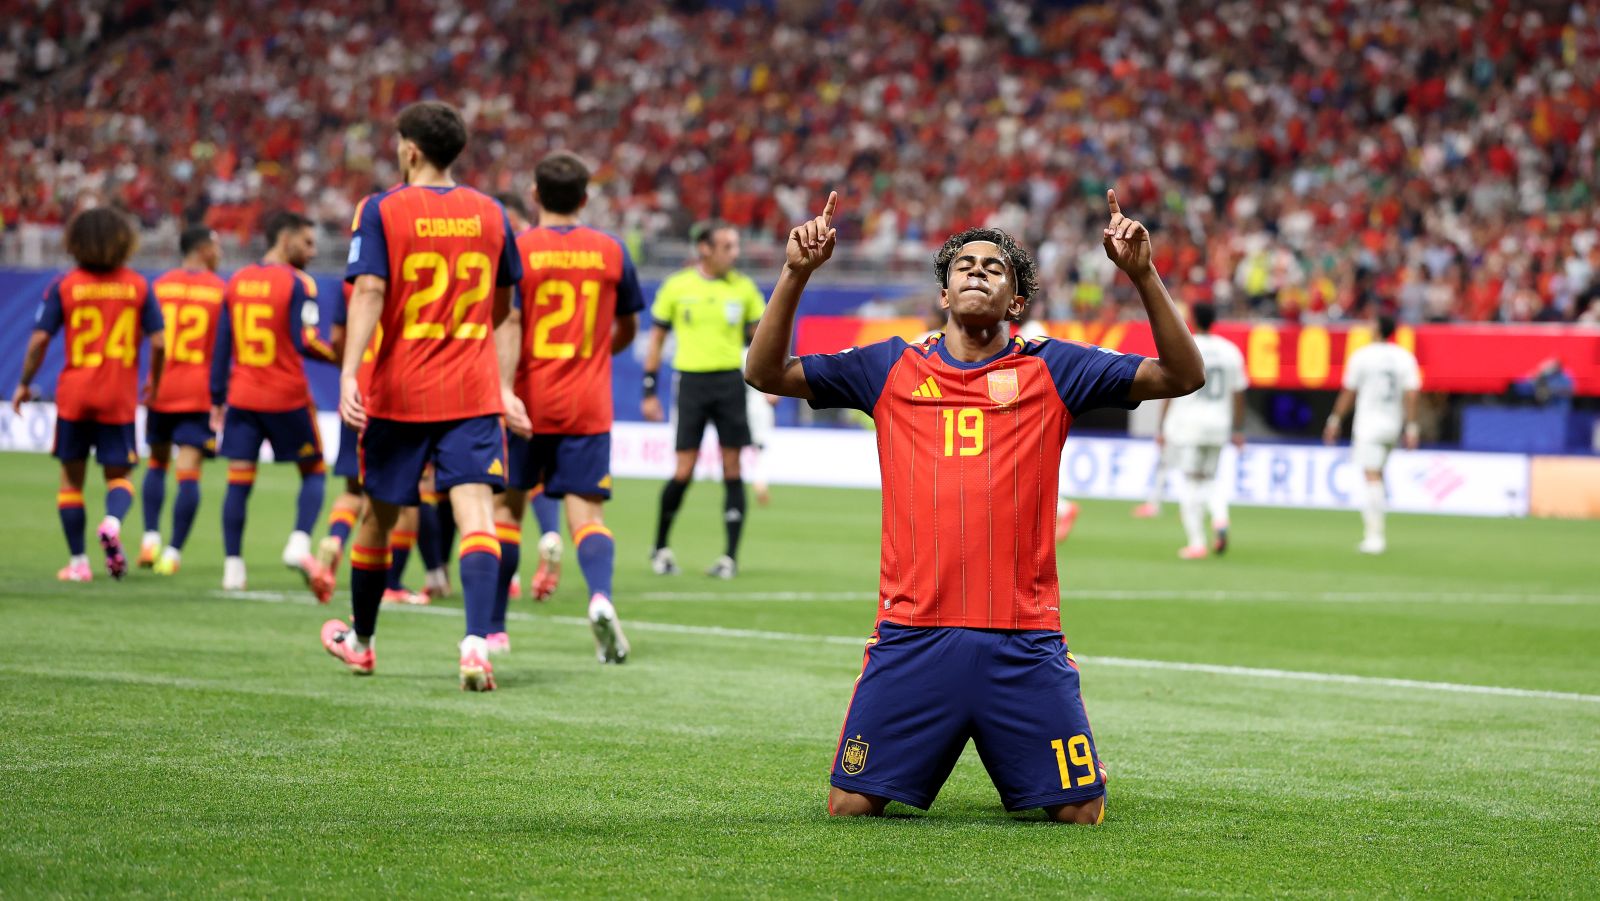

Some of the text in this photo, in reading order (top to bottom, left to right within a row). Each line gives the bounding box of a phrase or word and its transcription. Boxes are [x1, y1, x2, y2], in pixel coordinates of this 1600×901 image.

[403, 252, 492, 339] 22
[533, 280, 601, 359] 21
[71, 306, 137, 368] 24
[161, 303, 210, 364] 12
[233, 303, 276, 366] 15
[942, 408, 985, 457] 19
[1069, 445, 1123, 493] OF
[1050, 734, 1097, 790] 19
